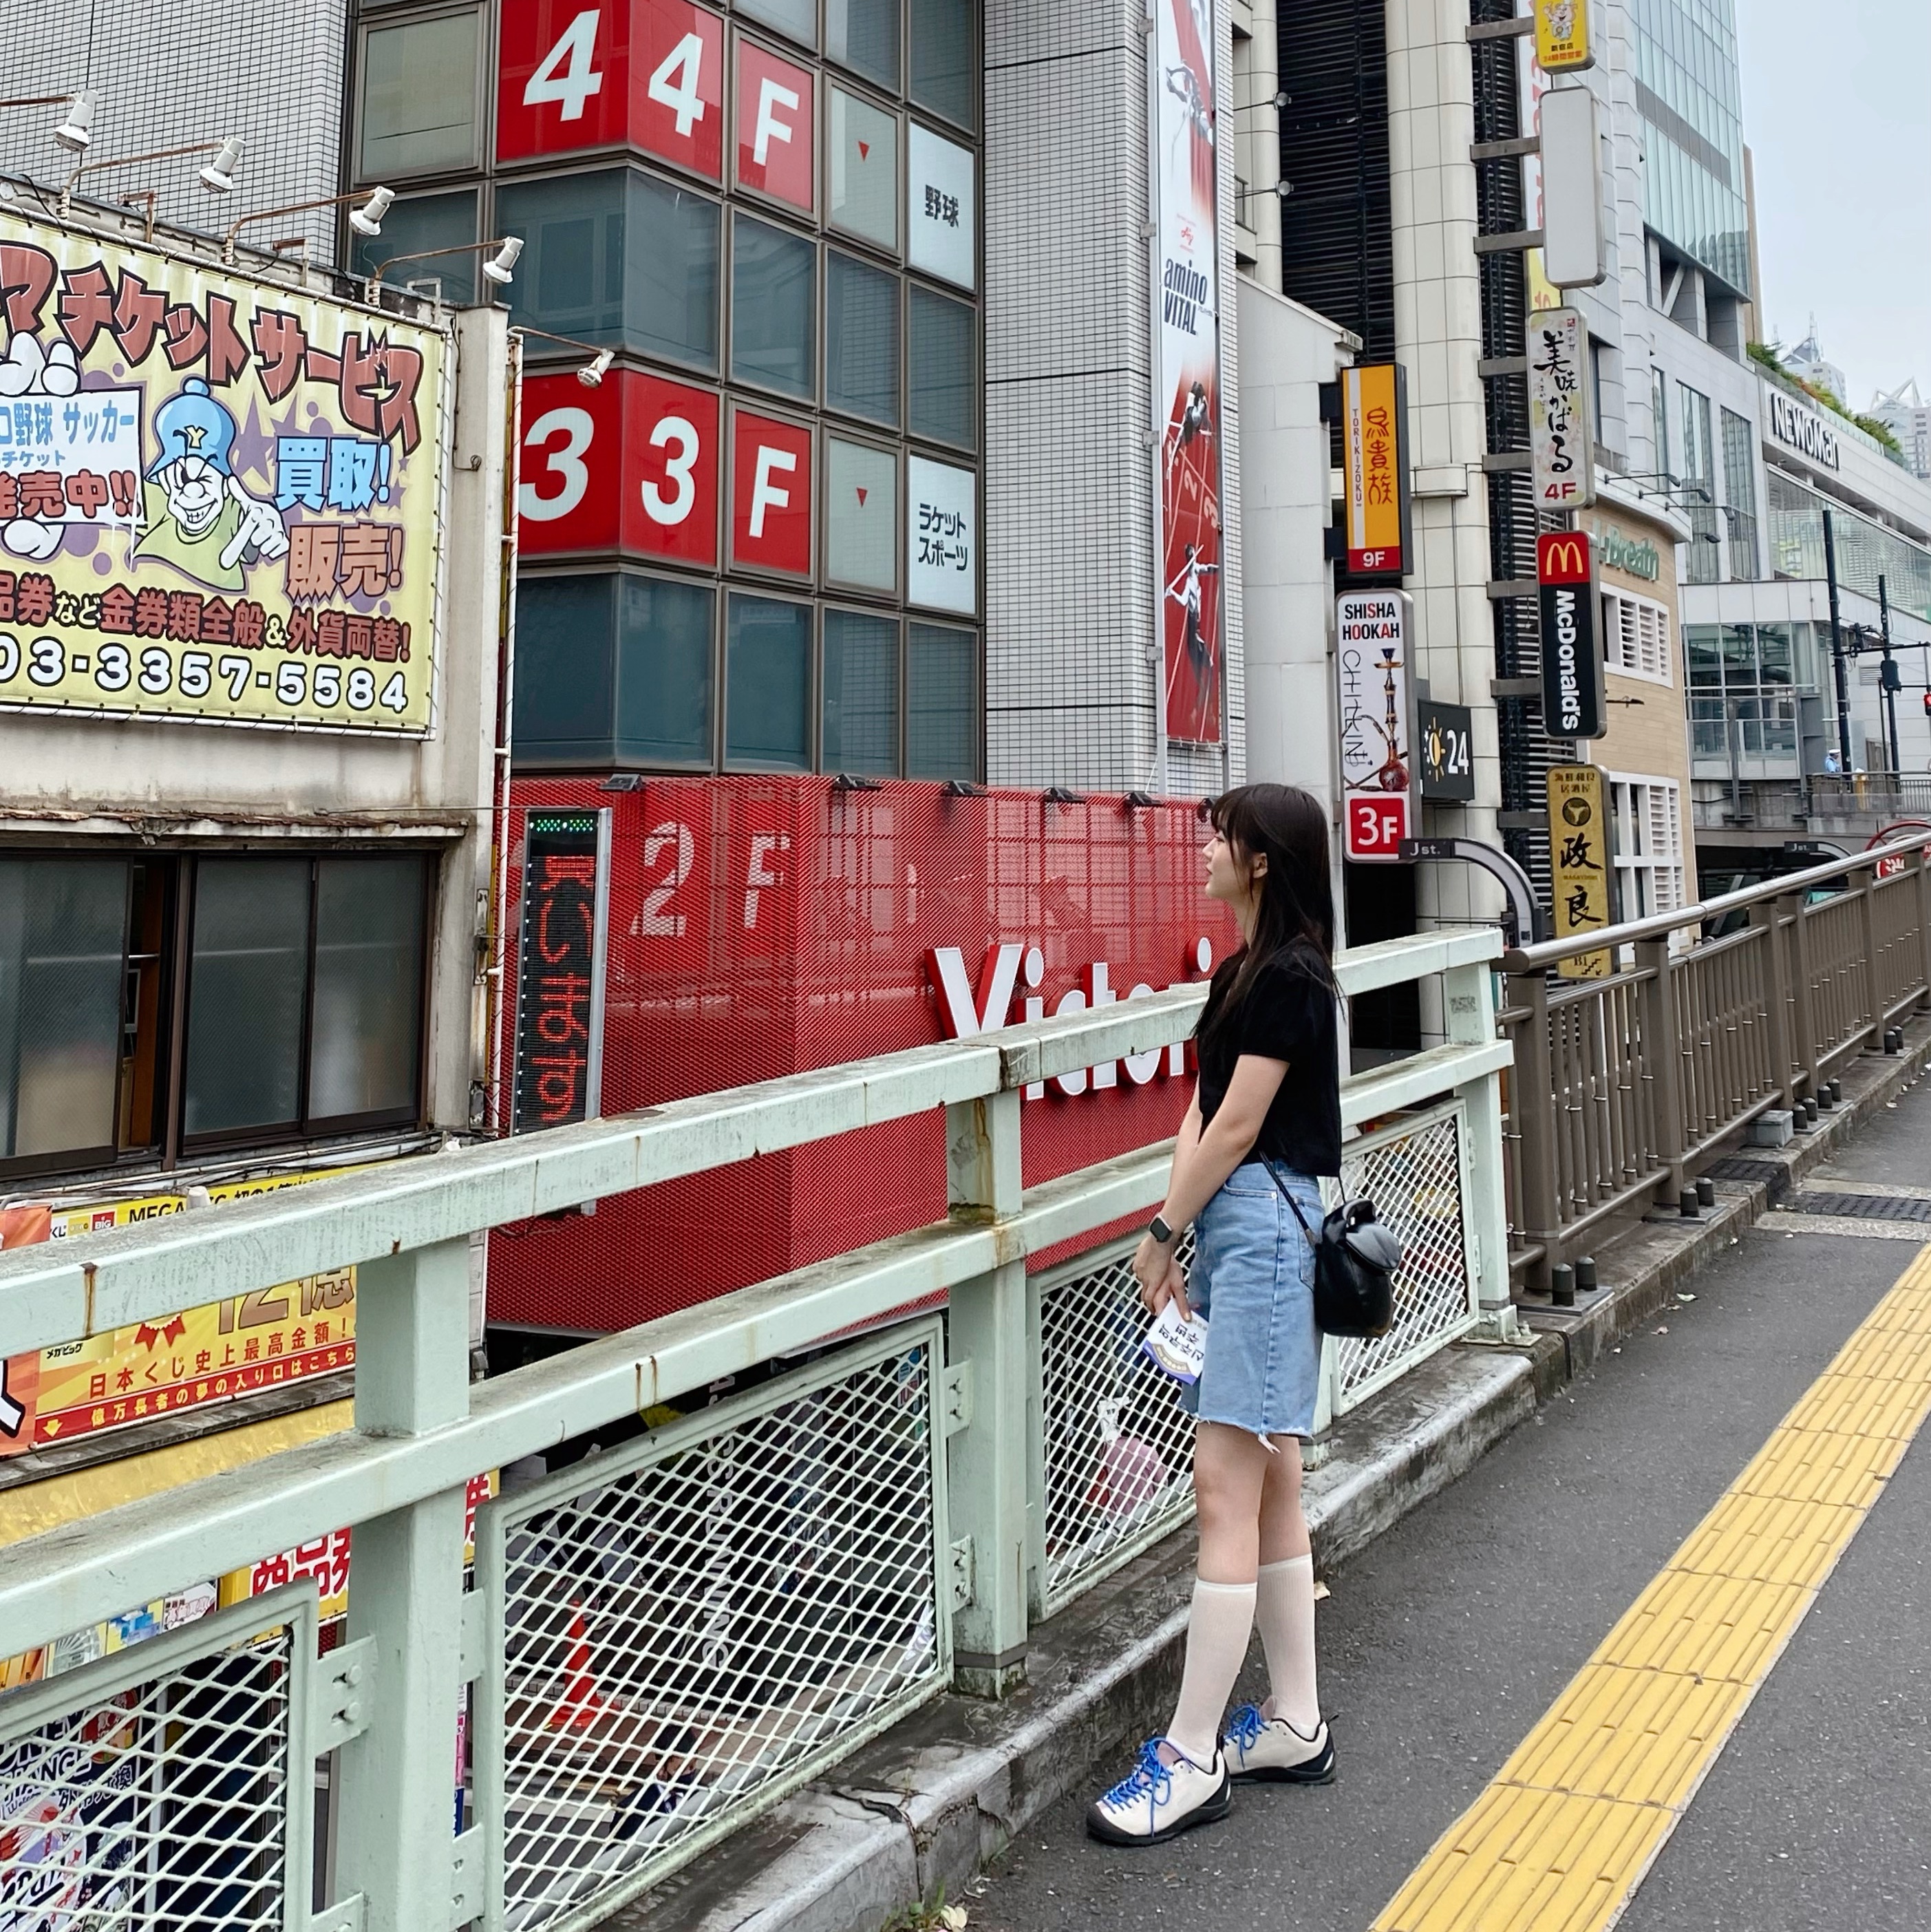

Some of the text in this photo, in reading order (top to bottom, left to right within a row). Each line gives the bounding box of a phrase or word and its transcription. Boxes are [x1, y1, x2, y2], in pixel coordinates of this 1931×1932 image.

[522, 8, 603, 121] 4
[925, 183, 960, 229] 野球
[1164, 258, 1208, 305] amino
[1164, 290, 1197, 336] VITAL
[63, 399, 134, 445] サッカー
[276, 435, 392, 511] 買取!
[517, 407, 595, 522] 3
[1352, 409, 1362, 502] TORIKIZOKU
[1366, 406, 1393, 505] 鳥貴族
[1544, 482, 1576, 500] 4F
[919, 502, 966, 540] ラケット
[286, 524, 404, 602] 販売!
[917, 537, 969, 573] スポーツ
[1363, 551, 1385, 568] 9F
[1343, 622, 1400, 640] HOOKAH
[1345, 602, 1396, 619] SHISHA
[1556, 590, 1581, 730] McDonald's
[1447, 729, 1469, 776] 24
[1358, 807, 1398, 846] 3F
[629, 820, 694, 937] 2
[46, 1342, 83, 1359] メガビッグ
